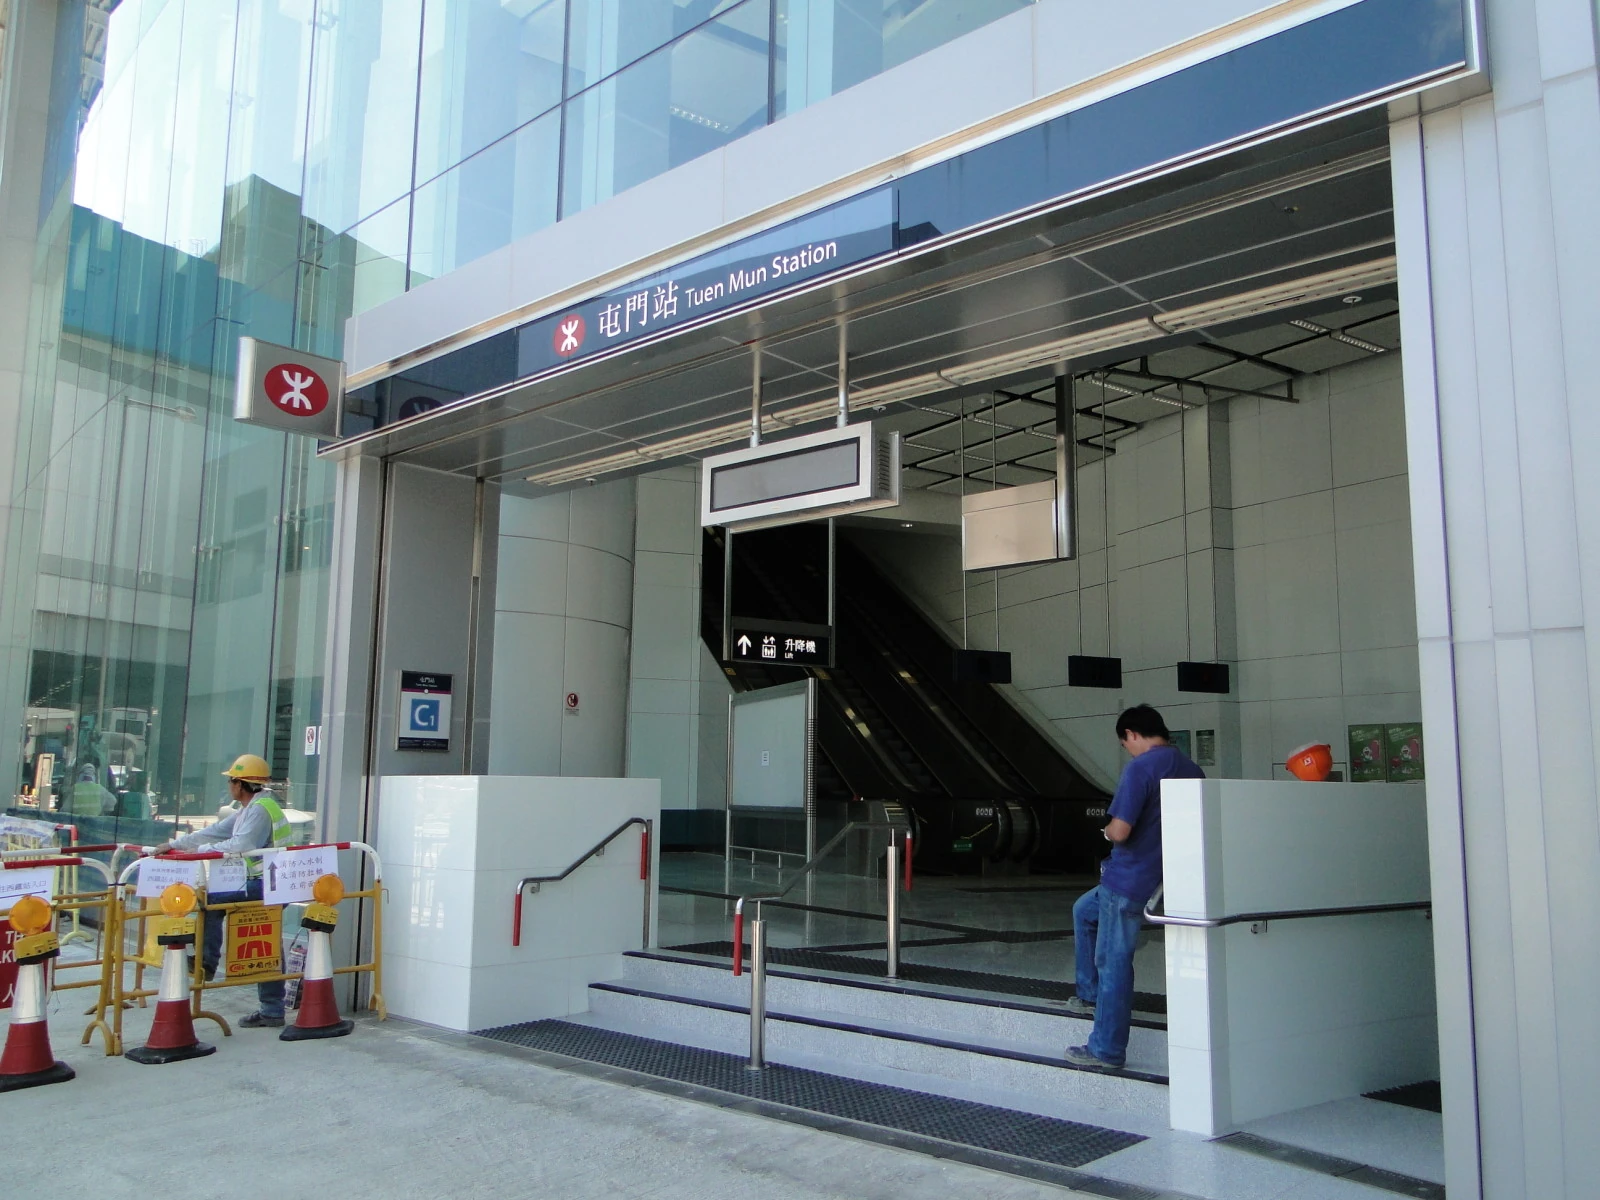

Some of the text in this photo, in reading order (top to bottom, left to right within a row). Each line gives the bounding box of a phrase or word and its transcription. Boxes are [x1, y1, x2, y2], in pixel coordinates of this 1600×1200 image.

[598, 241, 837, 338] 屯門站 Tuen Mun Station
[784, 639, 817, 654] 升降機
[414, 704, 435, 727] C1
